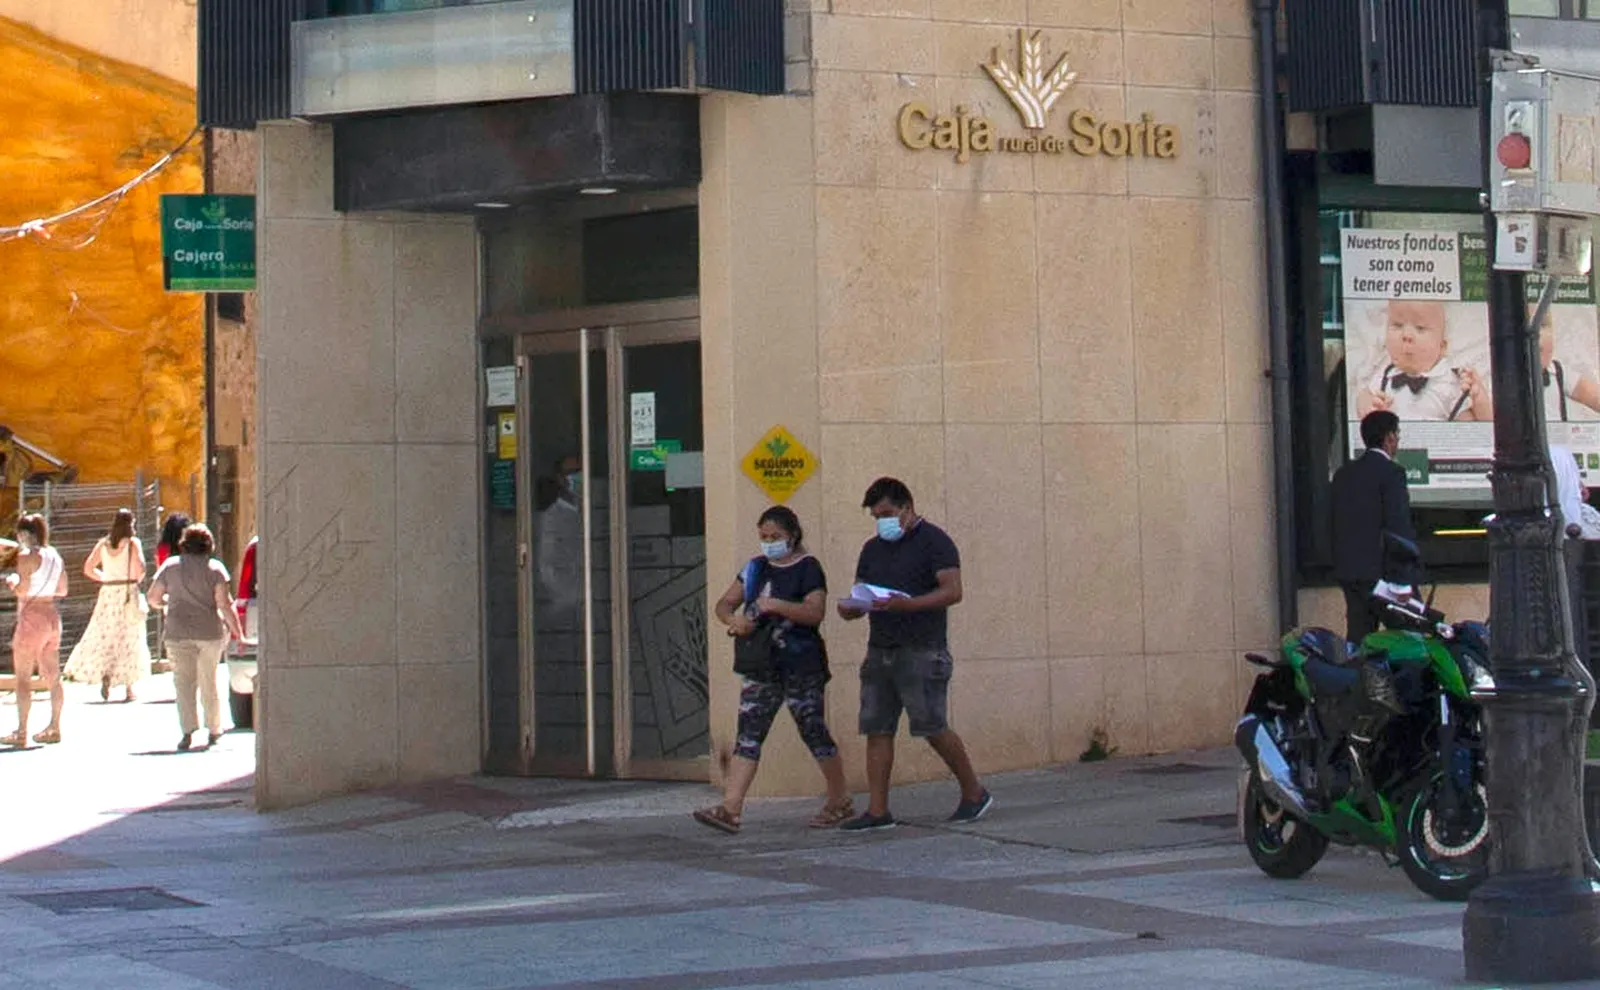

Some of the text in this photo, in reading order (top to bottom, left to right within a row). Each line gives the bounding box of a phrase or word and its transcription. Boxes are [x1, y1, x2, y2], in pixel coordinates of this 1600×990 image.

[897, 101, 1181, 164] Caja rural de Soria
[174, 217, 204, 232] Caja
[222, 217, 255, 231] Soria
[1346, 232, 1455, 255] Nuestros fondos
[173, 249, 225, 264] Cajero
[1368, 258, 1435, 273] son como
[1353, 277, 1391, 292] tener
[1393, 276, 1453, 297] gemelos
[753, 457, 805, 470] SEGUROS
